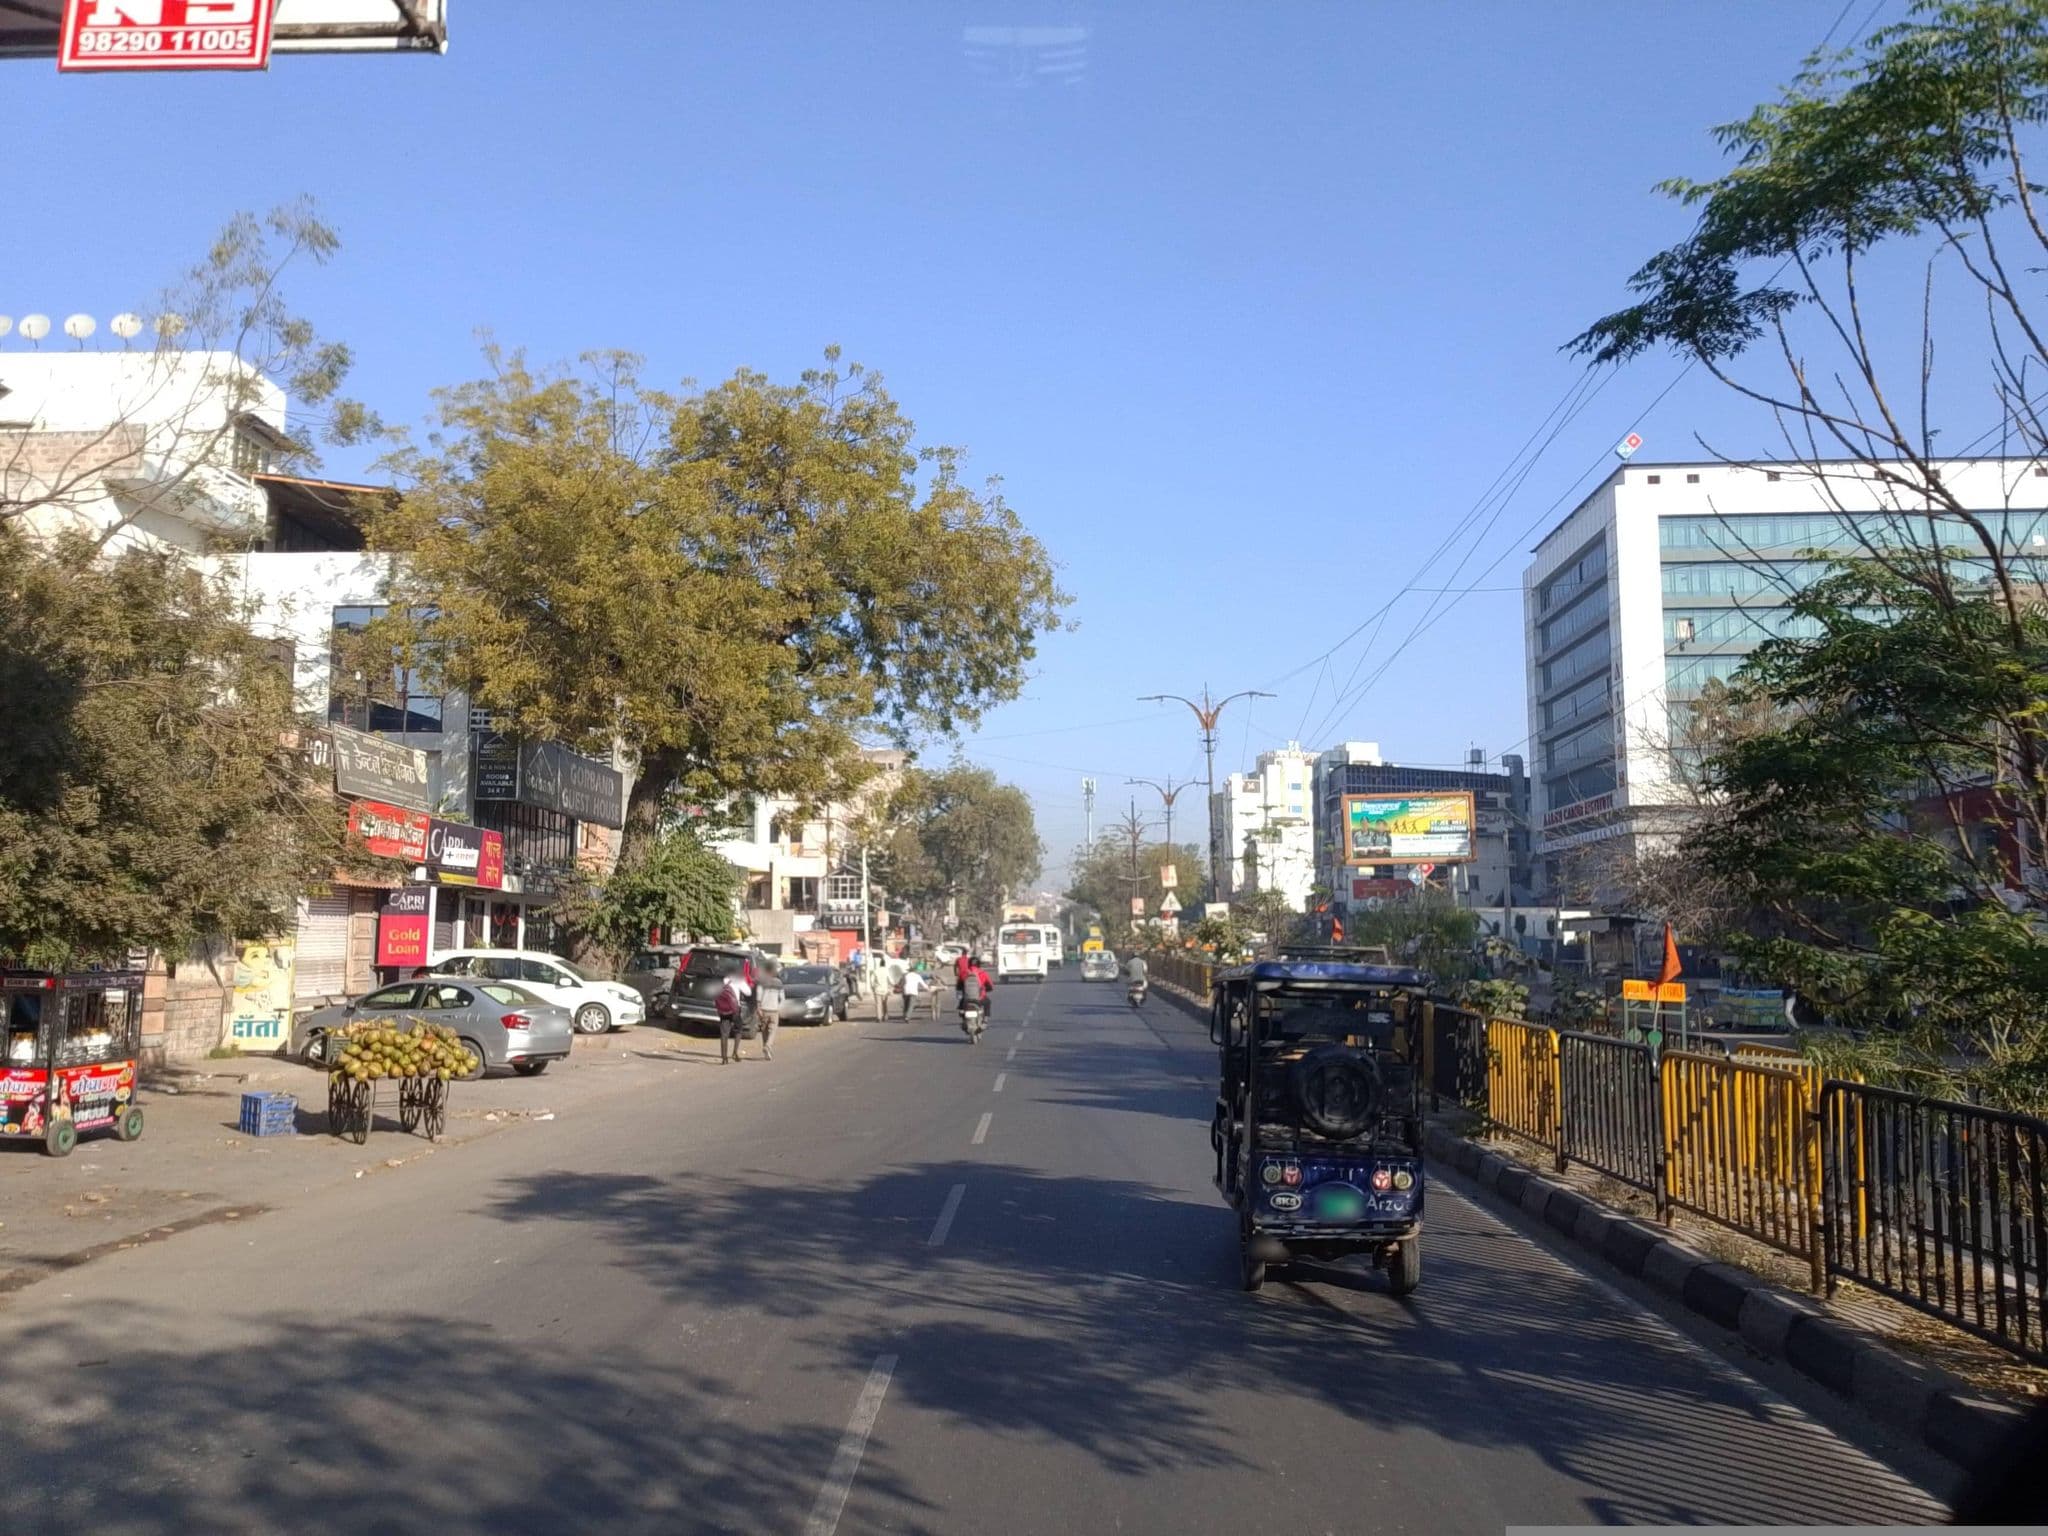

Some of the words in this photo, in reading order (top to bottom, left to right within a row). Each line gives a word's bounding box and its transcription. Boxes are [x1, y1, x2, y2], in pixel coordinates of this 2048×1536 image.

[78, 31, 161, 52] 98290
[170, 29, 252, 51] 11005
[570, 763, 614, 796] GORBAND
[562, 786, 590, 814] GUEST
[593, 794, 620, 821] HOUSE
[430, 827, 464, 858] CAPRI
[389, 892, 425, 906] CAPRI
[388, 928, 421, 942] Gold
[387, 943, 420, 955] Loan
